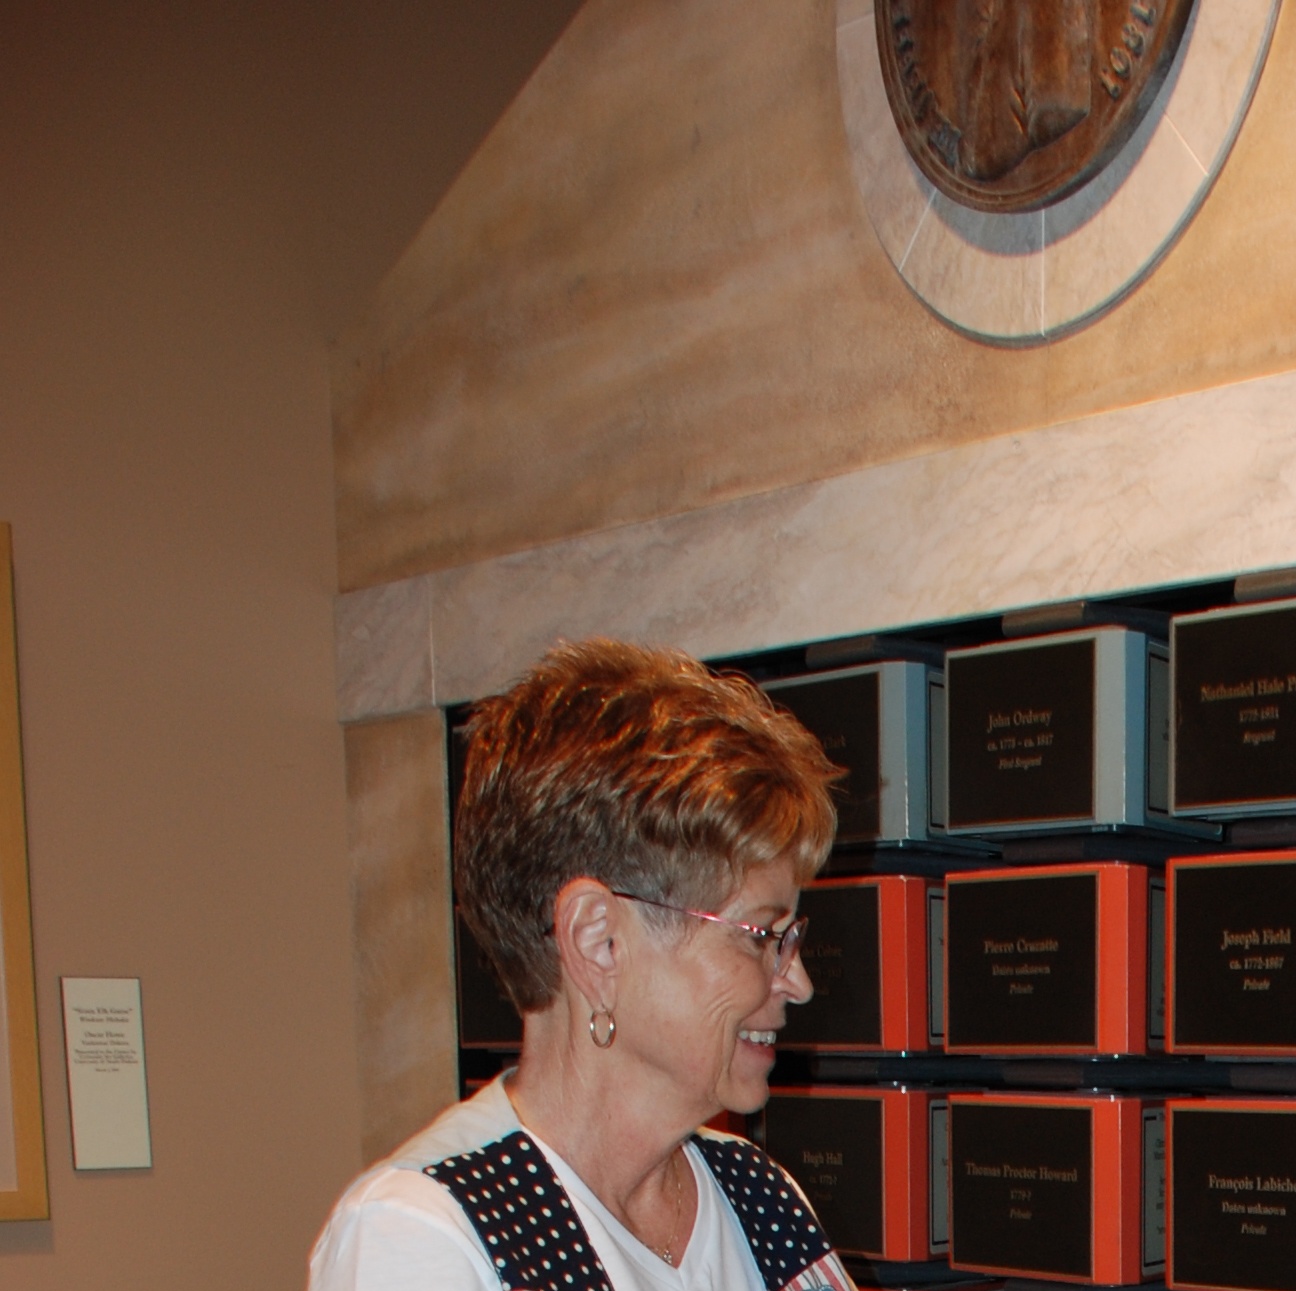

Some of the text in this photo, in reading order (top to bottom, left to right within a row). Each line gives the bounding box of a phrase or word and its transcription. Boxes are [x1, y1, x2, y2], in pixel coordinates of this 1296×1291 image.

[987, 710, 1052, 733] John Ordway
[1221, 929, 1292, 950] Joseph Field
[965, 1162, 1001, 1178] Thomas
[1039, 1167, 1078, 1182] Howard
[1208, 1174, 1254, 1194] François
[1221, 1201, 1286, 1216] Dates unknown
